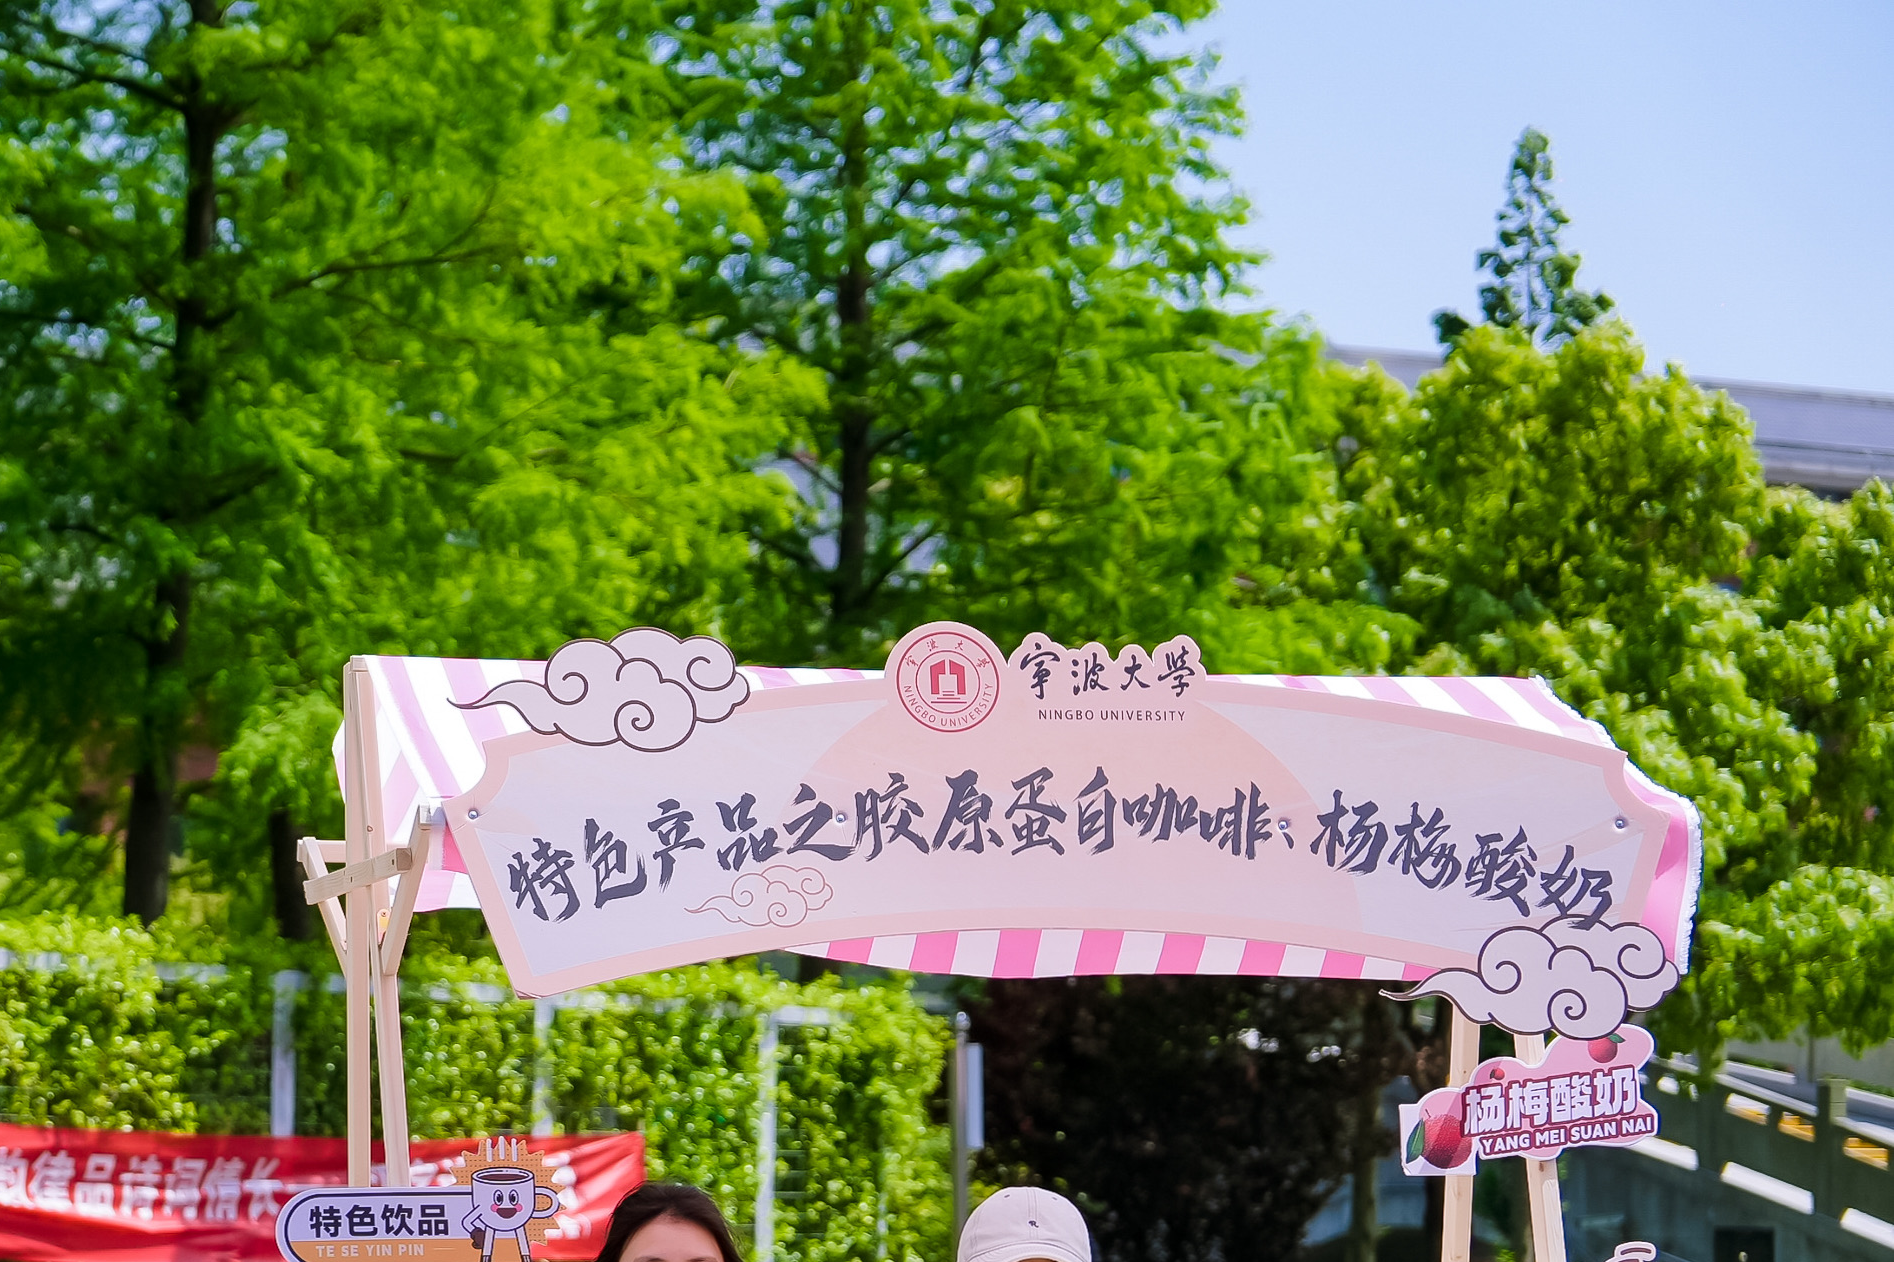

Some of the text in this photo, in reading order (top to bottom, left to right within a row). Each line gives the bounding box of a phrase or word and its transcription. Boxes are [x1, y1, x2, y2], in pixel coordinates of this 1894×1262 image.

[903, 682, 994, 728] NINGBO UNIVERSITY
[1038, 709, 1186, 722] NINGBO UNIVERSITY
[507, 766, 1616, 930] 特色产品之胶原蛋白咖啡、杨梅酸奶
[1464, 1067, 1637, 1135] 杨梅酸奶
[1481, 1117, 1653, 1154] YANG MEI SUAN NAI
[310, 1203, 449, 1239] 特色饮品
[316, 1243, 425, 1258] TE SE YIN PIN
